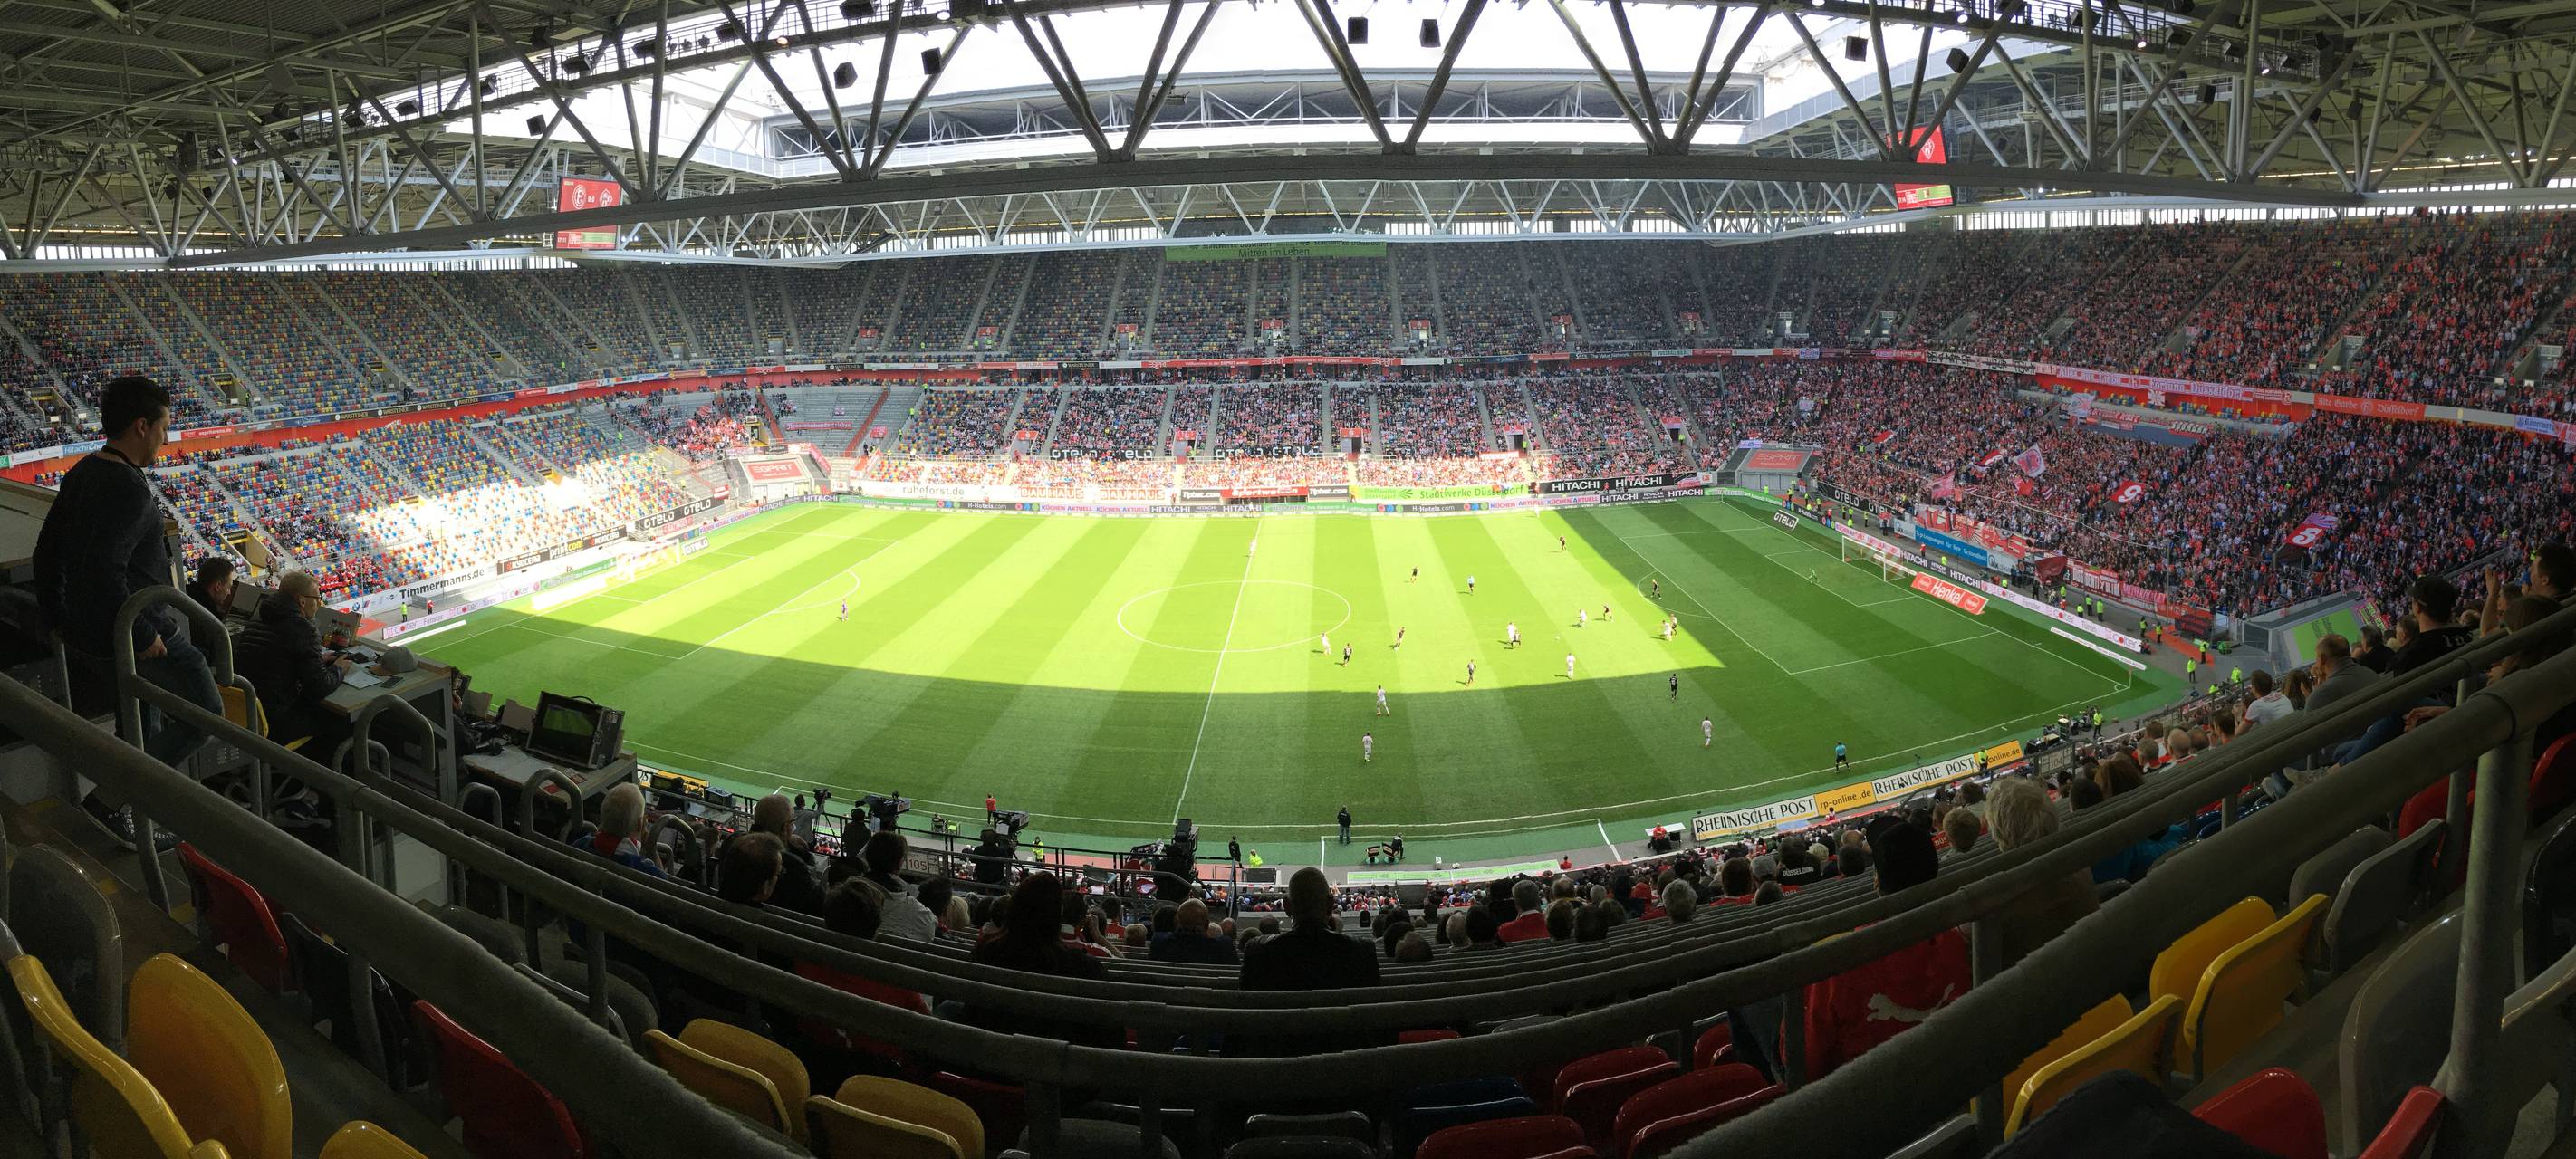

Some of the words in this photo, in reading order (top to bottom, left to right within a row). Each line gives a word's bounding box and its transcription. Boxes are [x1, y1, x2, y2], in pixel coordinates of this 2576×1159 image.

[1239, 248, 1266, 258] Mitten
[1269, 249, 1281, 257] im
[1283, 246, 1312, 256] Leben.
[1552, 480, 1600, 492] HITACHI
[1615, 476, 1662, 488] HITACHI
[902, 485, 965, 496] ruheforst.de
[1021, 486, 1083, 499] BAUHAUS
[1101, 487, 1165, 500] BAUHAUS
[1419, 488, 1471, 499] Stadtwerke
[1668, 488, 1704, 497] HITACHI
[803, 494, 838, 503] HITACHI
[1601, 493, 1638, 503] HITACHI
[1151, 505, 1191, 513] HITACHI
[1412, 503, 1455, 512] H-Hotels.com
[1901, 551, 1927, 568] HITACHI
[399, 570, 485, 599] Timmermanns.de
[1950, 570, 1980, 589] HITACHI
[1930, 580, 1966, 605] Henkel
[1946, 758, 1975, 774] POST
[1779, 798, 1815, 817] POST
[908, 858, 928, 871] 105
